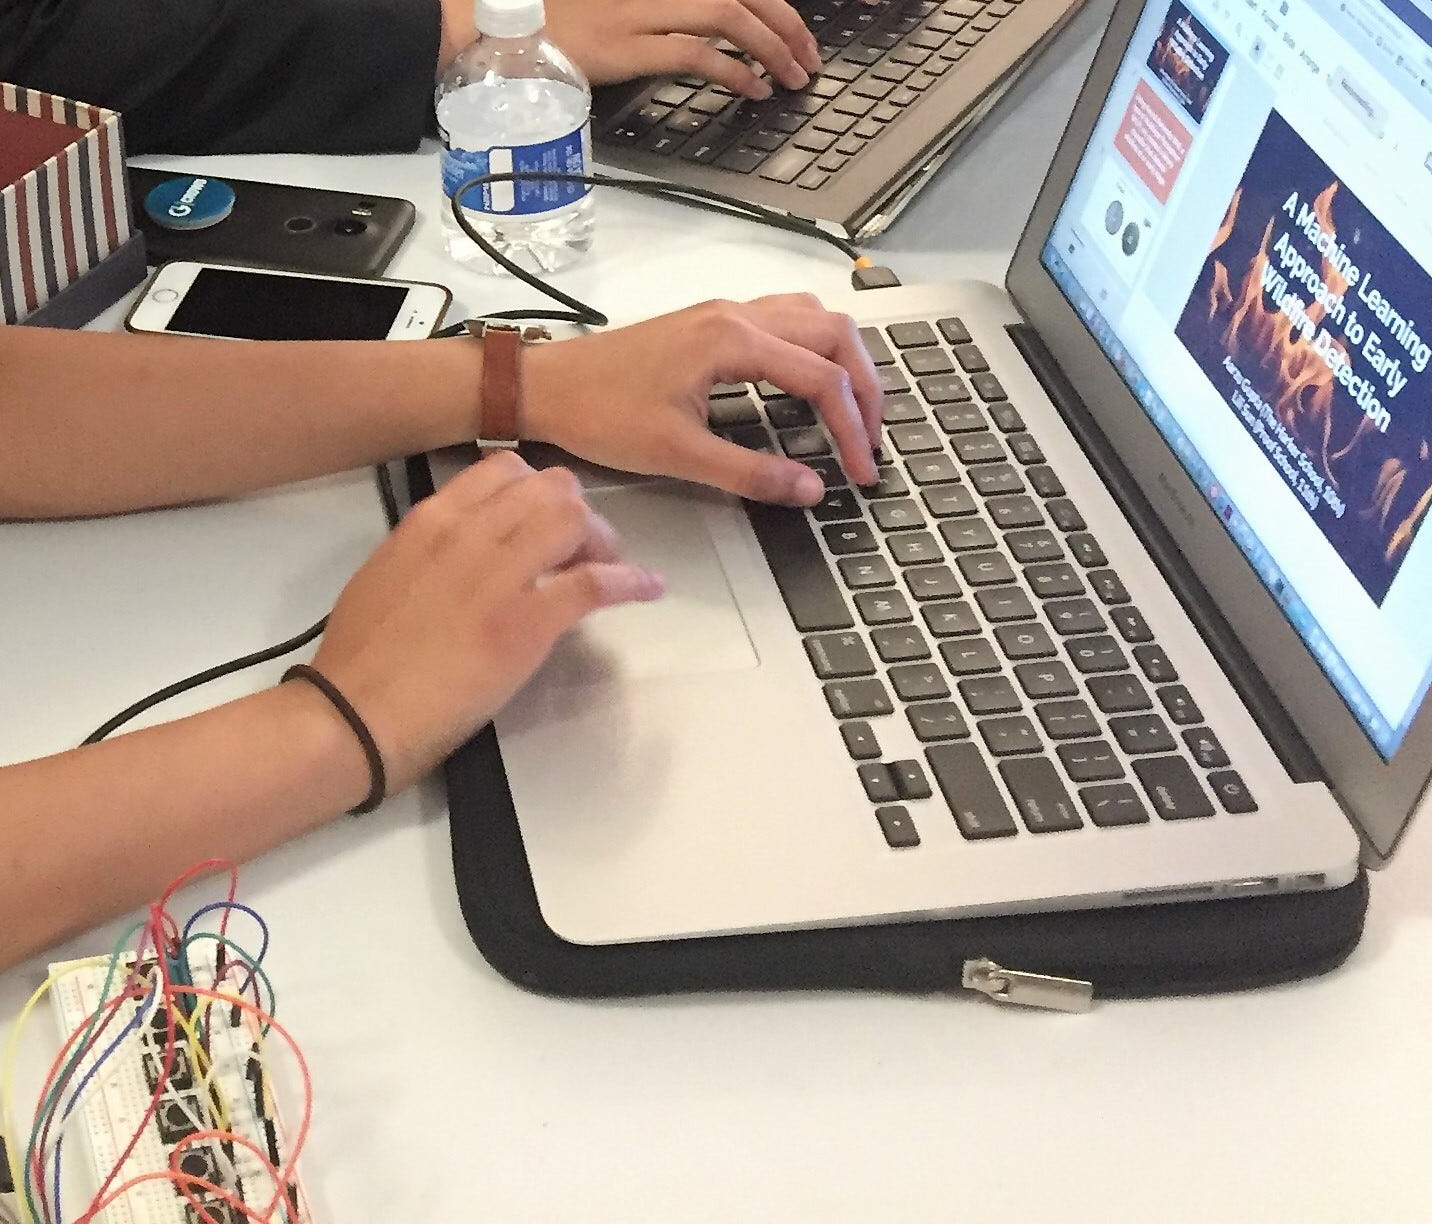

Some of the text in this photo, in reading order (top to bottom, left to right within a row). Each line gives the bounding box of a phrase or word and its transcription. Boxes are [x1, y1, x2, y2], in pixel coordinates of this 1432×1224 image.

[1260, 259, 1391, 433] Wildfire Detection
[1273, 232, 1408, 398] Approach to Early
[1281, 191, 1432, 372] A Machine Learning
